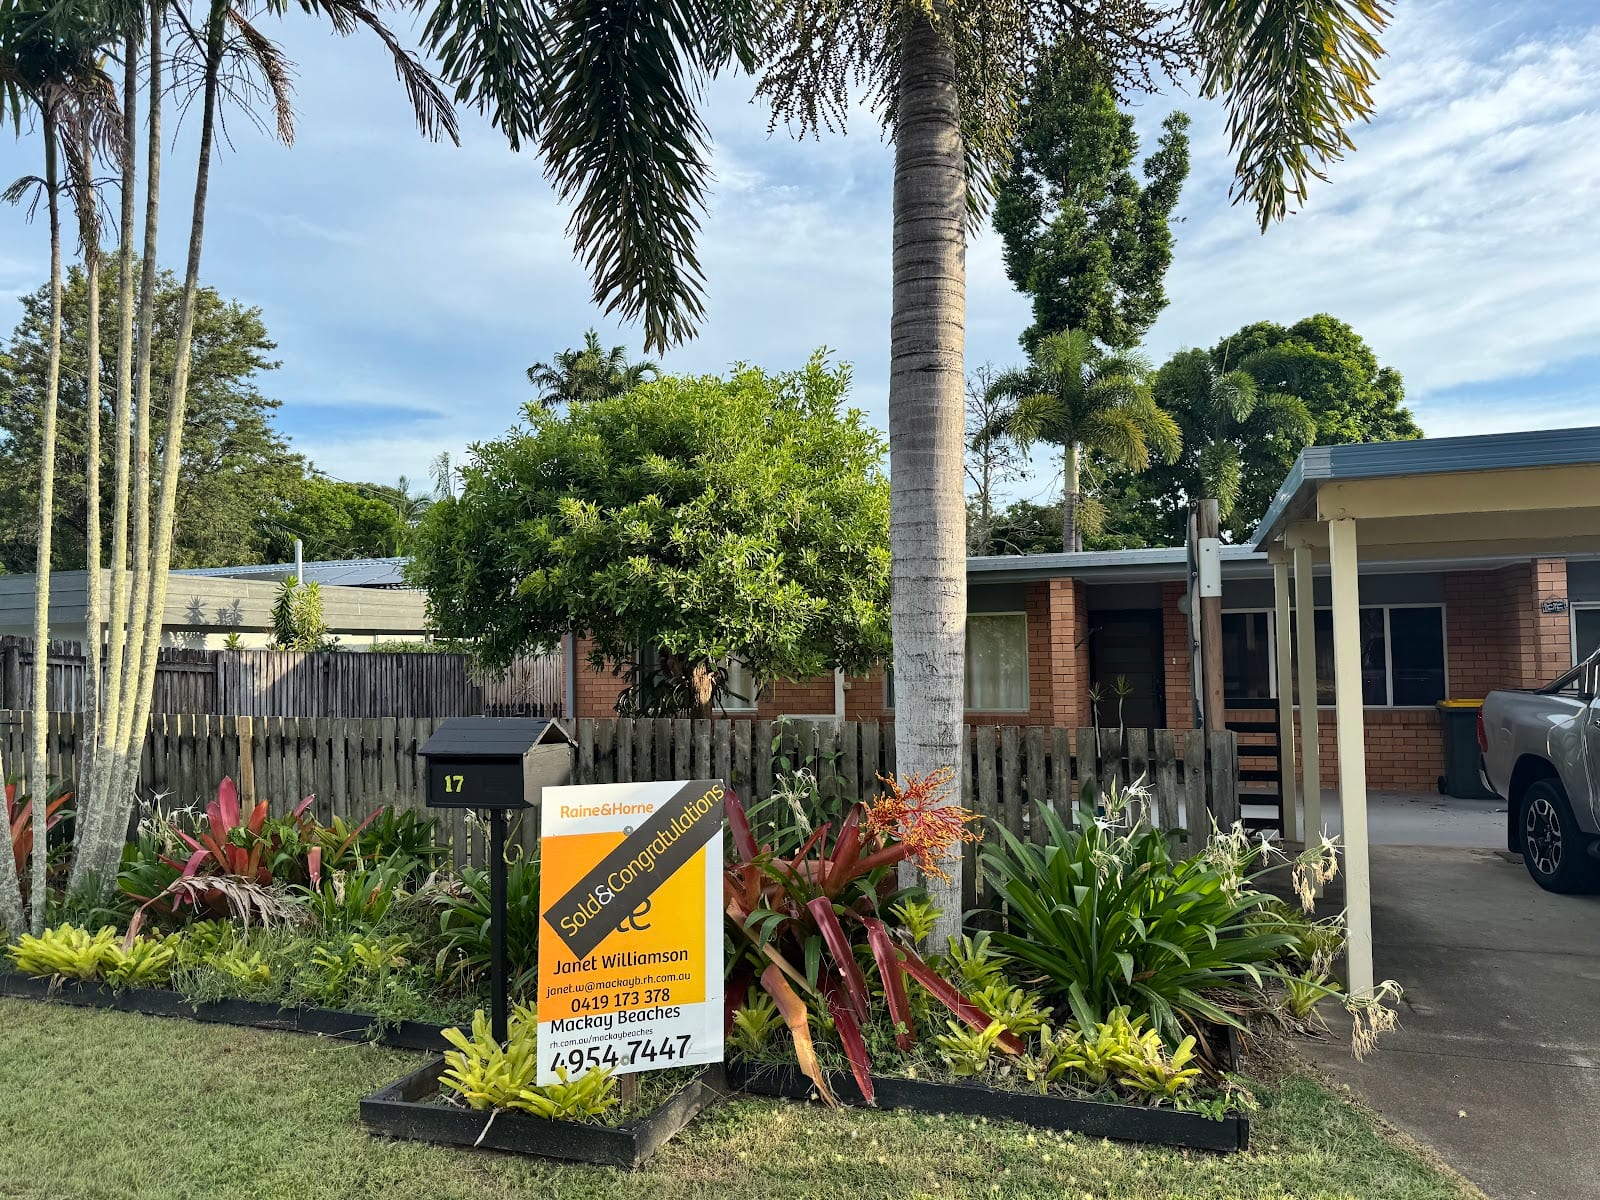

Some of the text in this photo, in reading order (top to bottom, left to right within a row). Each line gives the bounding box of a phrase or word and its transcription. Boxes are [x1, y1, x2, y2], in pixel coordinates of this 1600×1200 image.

[444, 775, 464, 793] 17
[560, 802, 654, 819] Raine&Horne
[553, 949, 688, 975] Janet Williamson
[546, 971, 691, 998] janet.w@mackayb.rh.com.au
[571, 988, 670, 1013] 0419 173 378
[550, 1005, 681, 1034] Mackay Beaches
[549, 1027, 653, 1049] rh.com.au/mackaybeaches
[550, 1034, 692, 1075] 4954 7447
